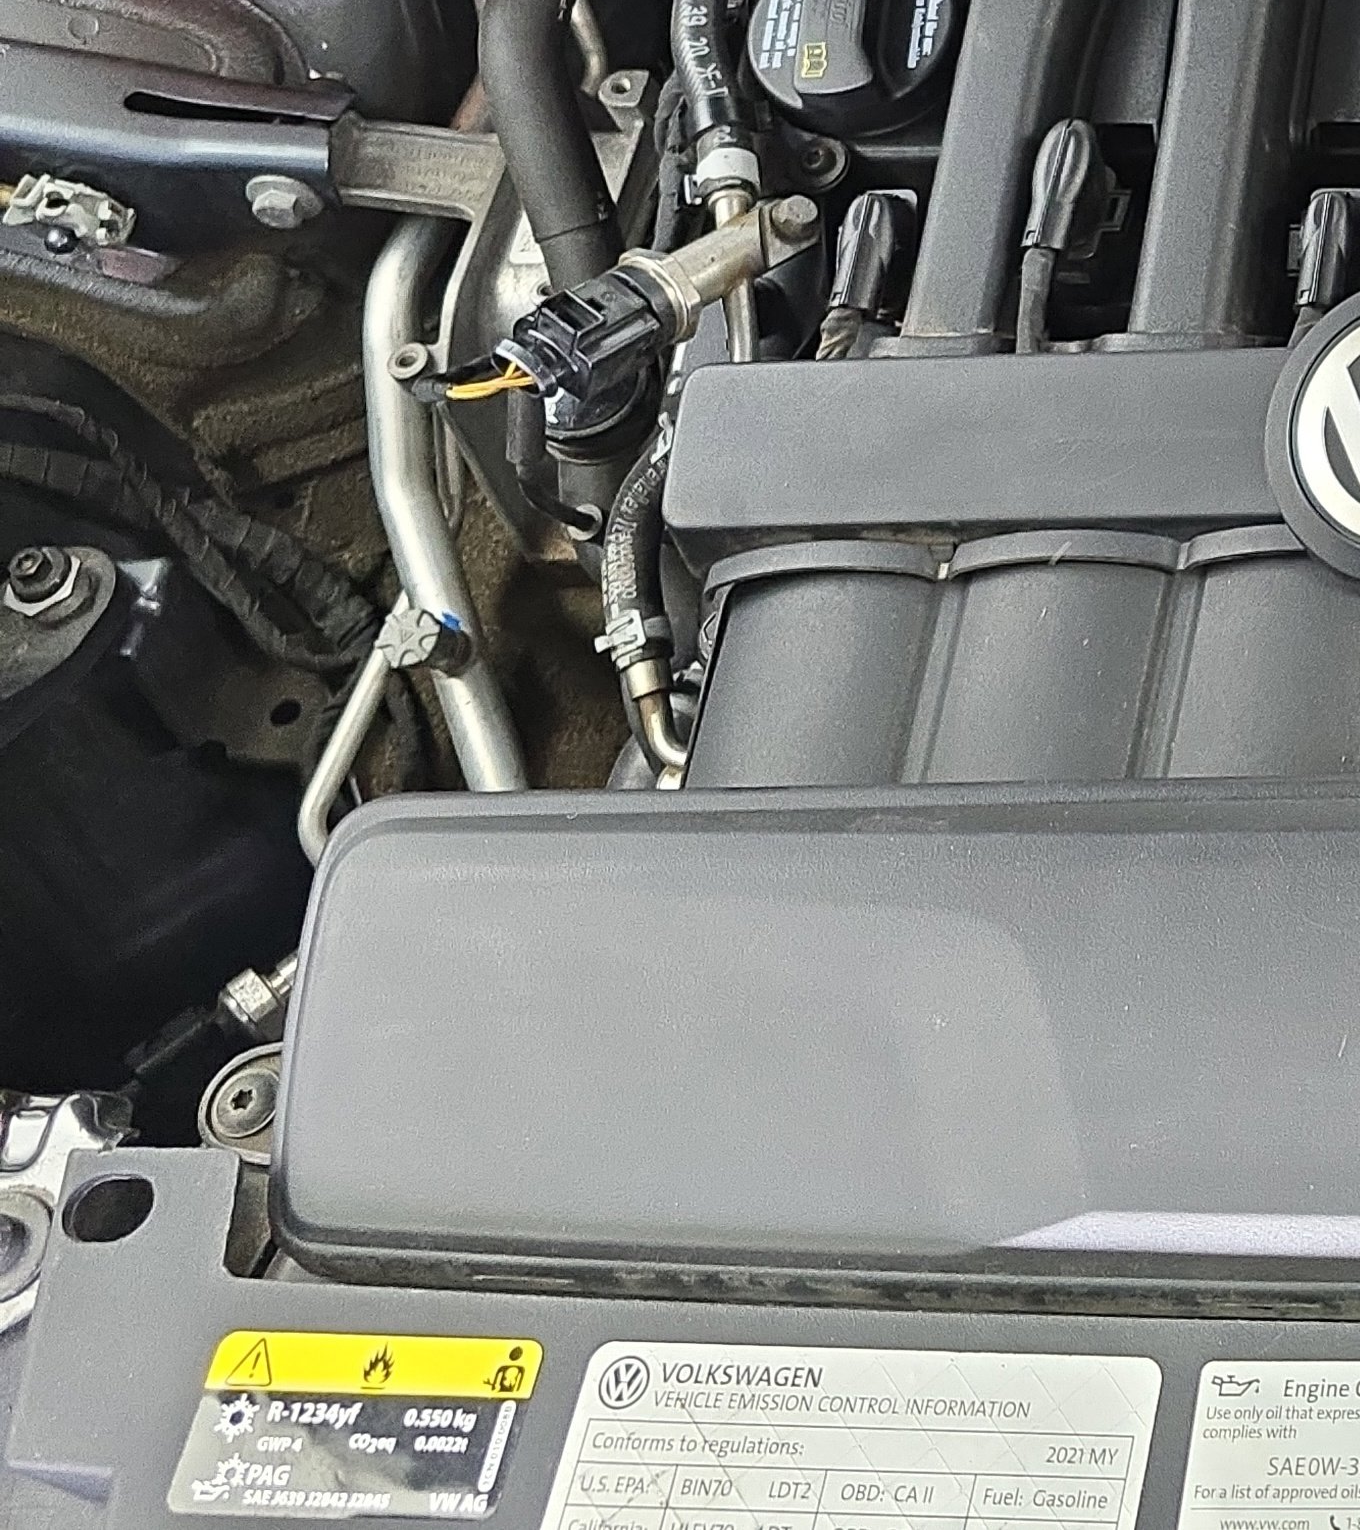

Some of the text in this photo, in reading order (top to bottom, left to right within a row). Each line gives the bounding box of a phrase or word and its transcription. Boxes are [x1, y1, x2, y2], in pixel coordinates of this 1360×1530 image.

[686, 6, 708, 25] 39
[688, 37, 710, 56] 20
[660, 1363, 823, 1388] VOLKSWAGEN
[1283, 1379, 1350, 1403] Engine
[654, 1391, 1031, 1418] VEHICLE EMISSION CONTROL INFORMATION
[267, 1401, 362, 1429] R-1234yf
[403, 1409, 477, 1432] 0.550 kg
[1206, 1406, 1231, 1420] Use
[1234, 1407, 1262, 1423] only
[1265, 1407, 1282, 1420] oil
[1285, 1407, 1313, 1420] that
[1203, 1426, 1297, 1442] complies with
[257, 1437, 302, 1452] GWP 4
[592, 1432, 804, 1457] Conforms to regulations:
[1045, 1446, 1118, 1465] 2021 MY
[247, 1465, 291, 1485] PAG
[580, 1475, 651, 1493] U.S. EPA:
[681, 1479, 732, 1496] BIN70
[768, 1481, 811, 1499] LDT2
[841, 1483, 934, 1503] OBD: CA II
[1194, 1485, 1216, 1500] For
[1219, 1488, 1227, 1500] a
[1231, 1485, 1251, 1500] list
[1255, 1485, 1271, 1500] of
[1272, 1485, 1337, 1503] approved
[243, 1490, 270, 1505] SAE
[271, 1491, 302, 1506] J639
[430, 1493, 488, 1513] VW AG
[983, 1488, 1108, 1509] Fuel: Gasoline
[1220, 1519, 1310, 1530] www.vw.com
